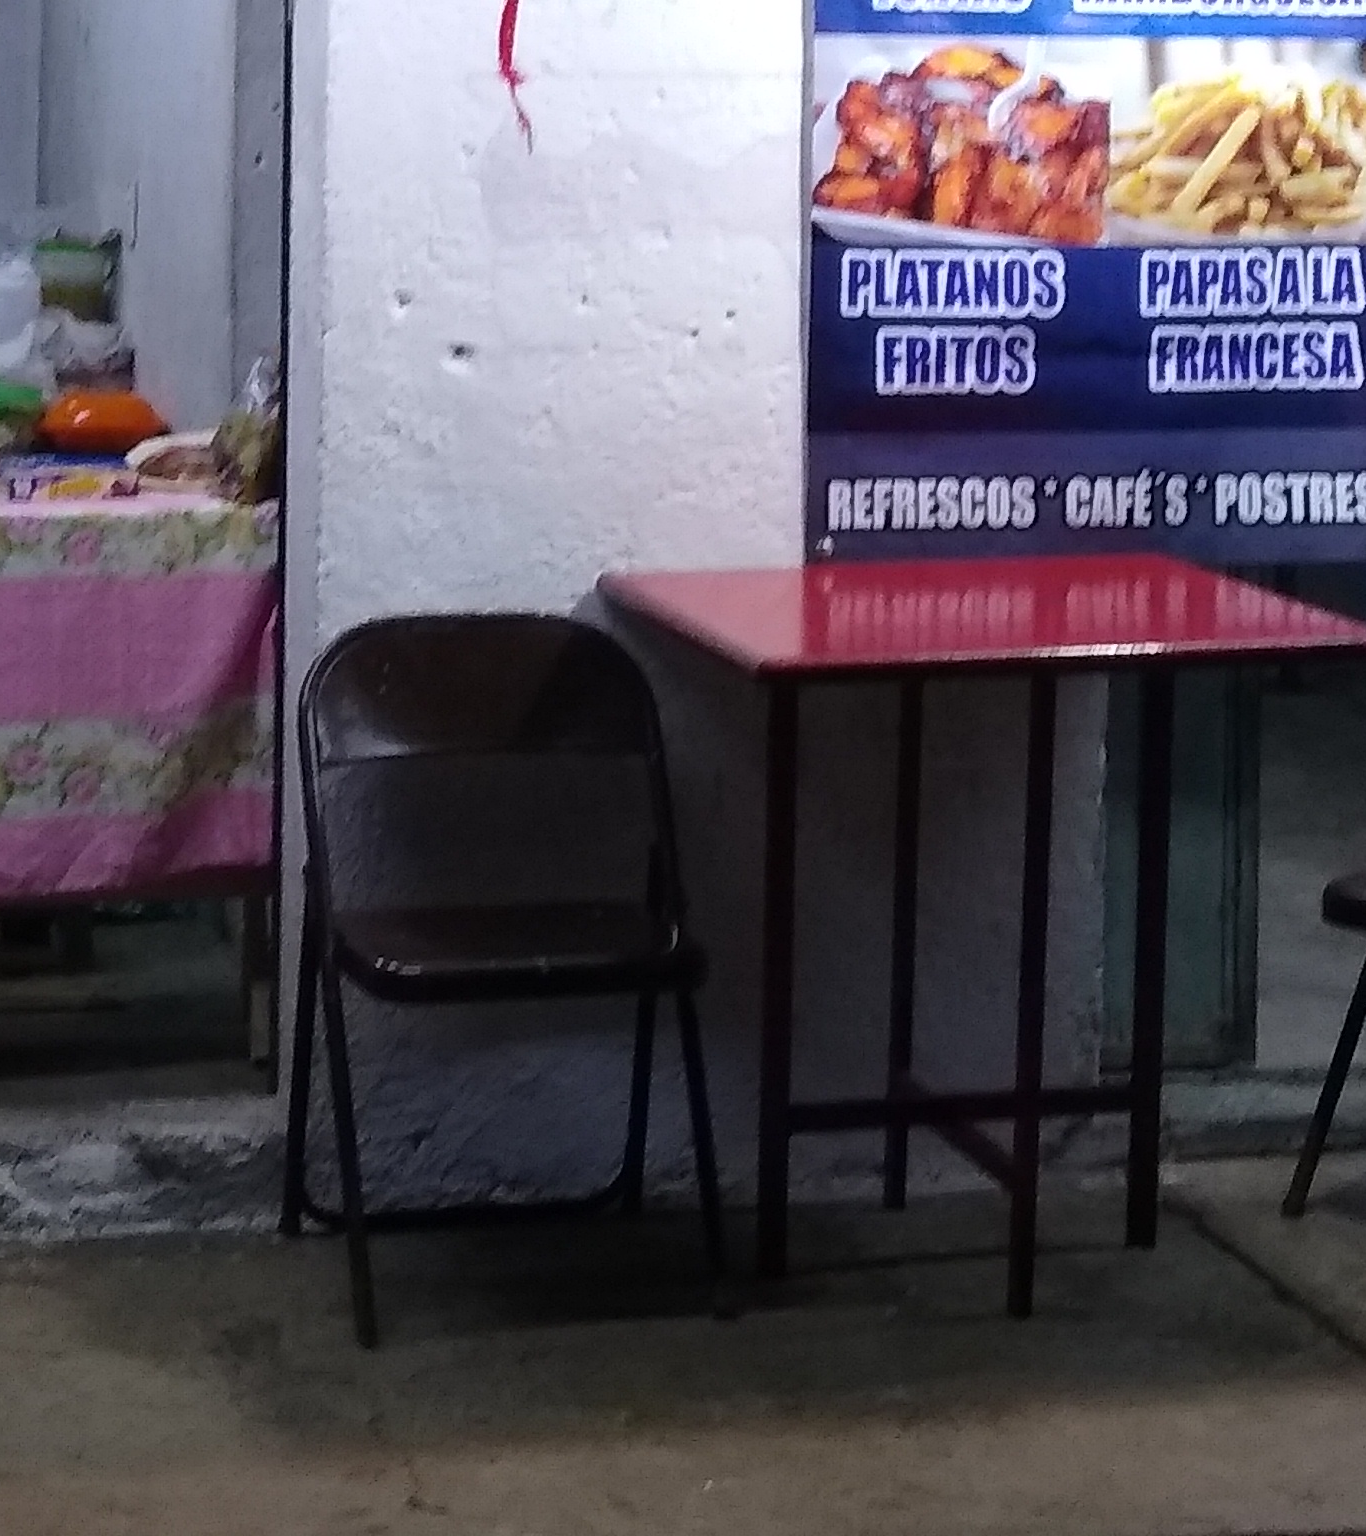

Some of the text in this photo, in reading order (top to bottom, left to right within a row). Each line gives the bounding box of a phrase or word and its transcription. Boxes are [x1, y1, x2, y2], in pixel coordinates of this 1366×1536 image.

[845, 254, 1064, 316] PLATANOS
[1146, 253, 1270, 312] PAPAS
[881, 329, 1360, 391] FRITOS FRANCESA
[828, 473, 1036, 531] REFRESCOS
